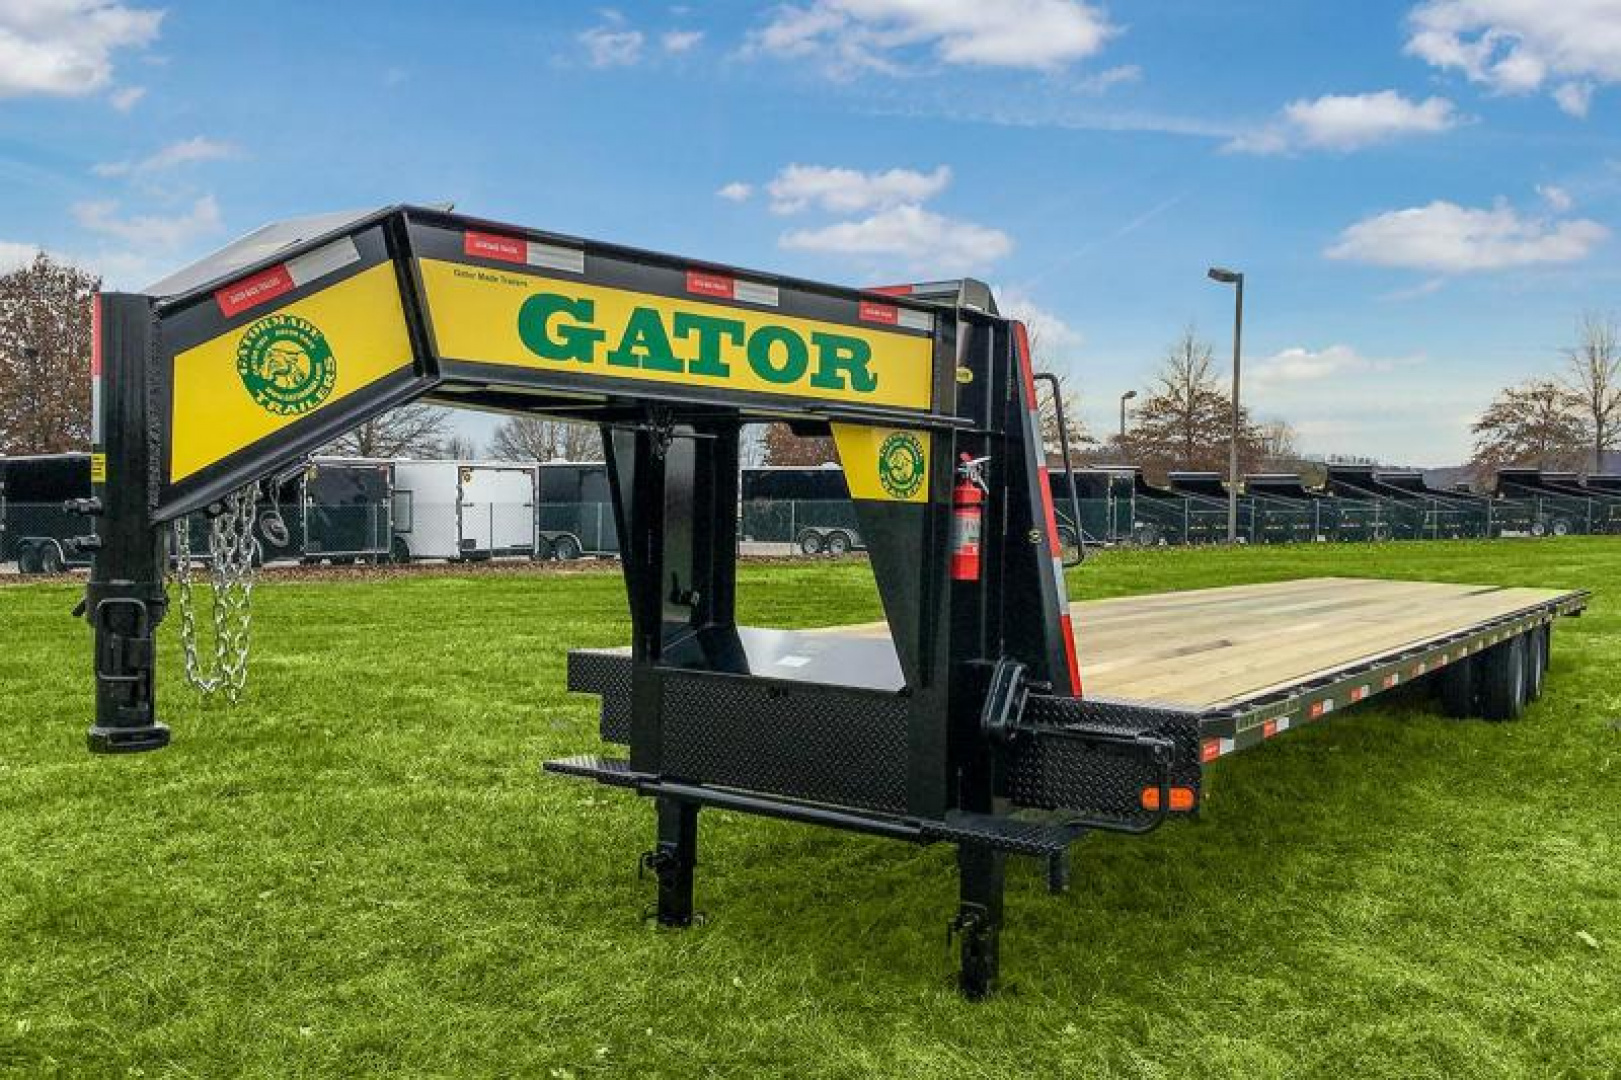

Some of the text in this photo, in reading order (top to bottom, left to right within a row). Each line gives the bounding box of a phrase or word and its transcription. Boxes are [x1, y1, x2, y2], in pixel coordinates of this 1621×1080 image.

[453, 269, 528, 287] Gator Made Trailers
[518, 292, 878, 392] GATOR
